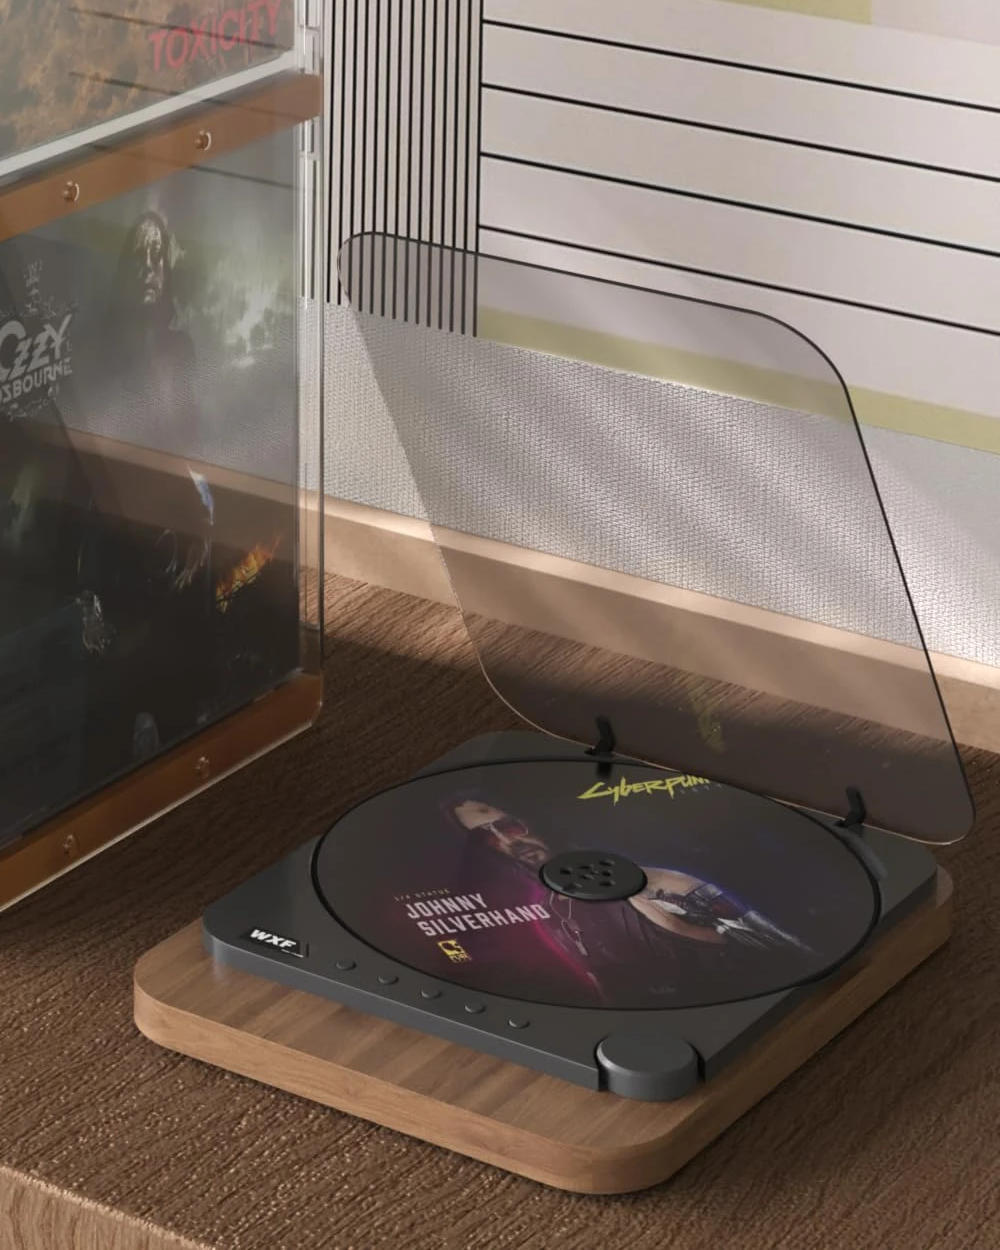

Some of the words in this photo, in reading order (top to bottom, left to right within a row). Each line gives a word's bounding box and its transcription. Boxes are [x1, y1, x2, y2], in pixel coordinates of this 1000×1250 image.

[404, 892, 489, 919] JOHNNY
[416, 903, 551, 937] SILVERHAND
[250, 928, 297, 949] WXF
